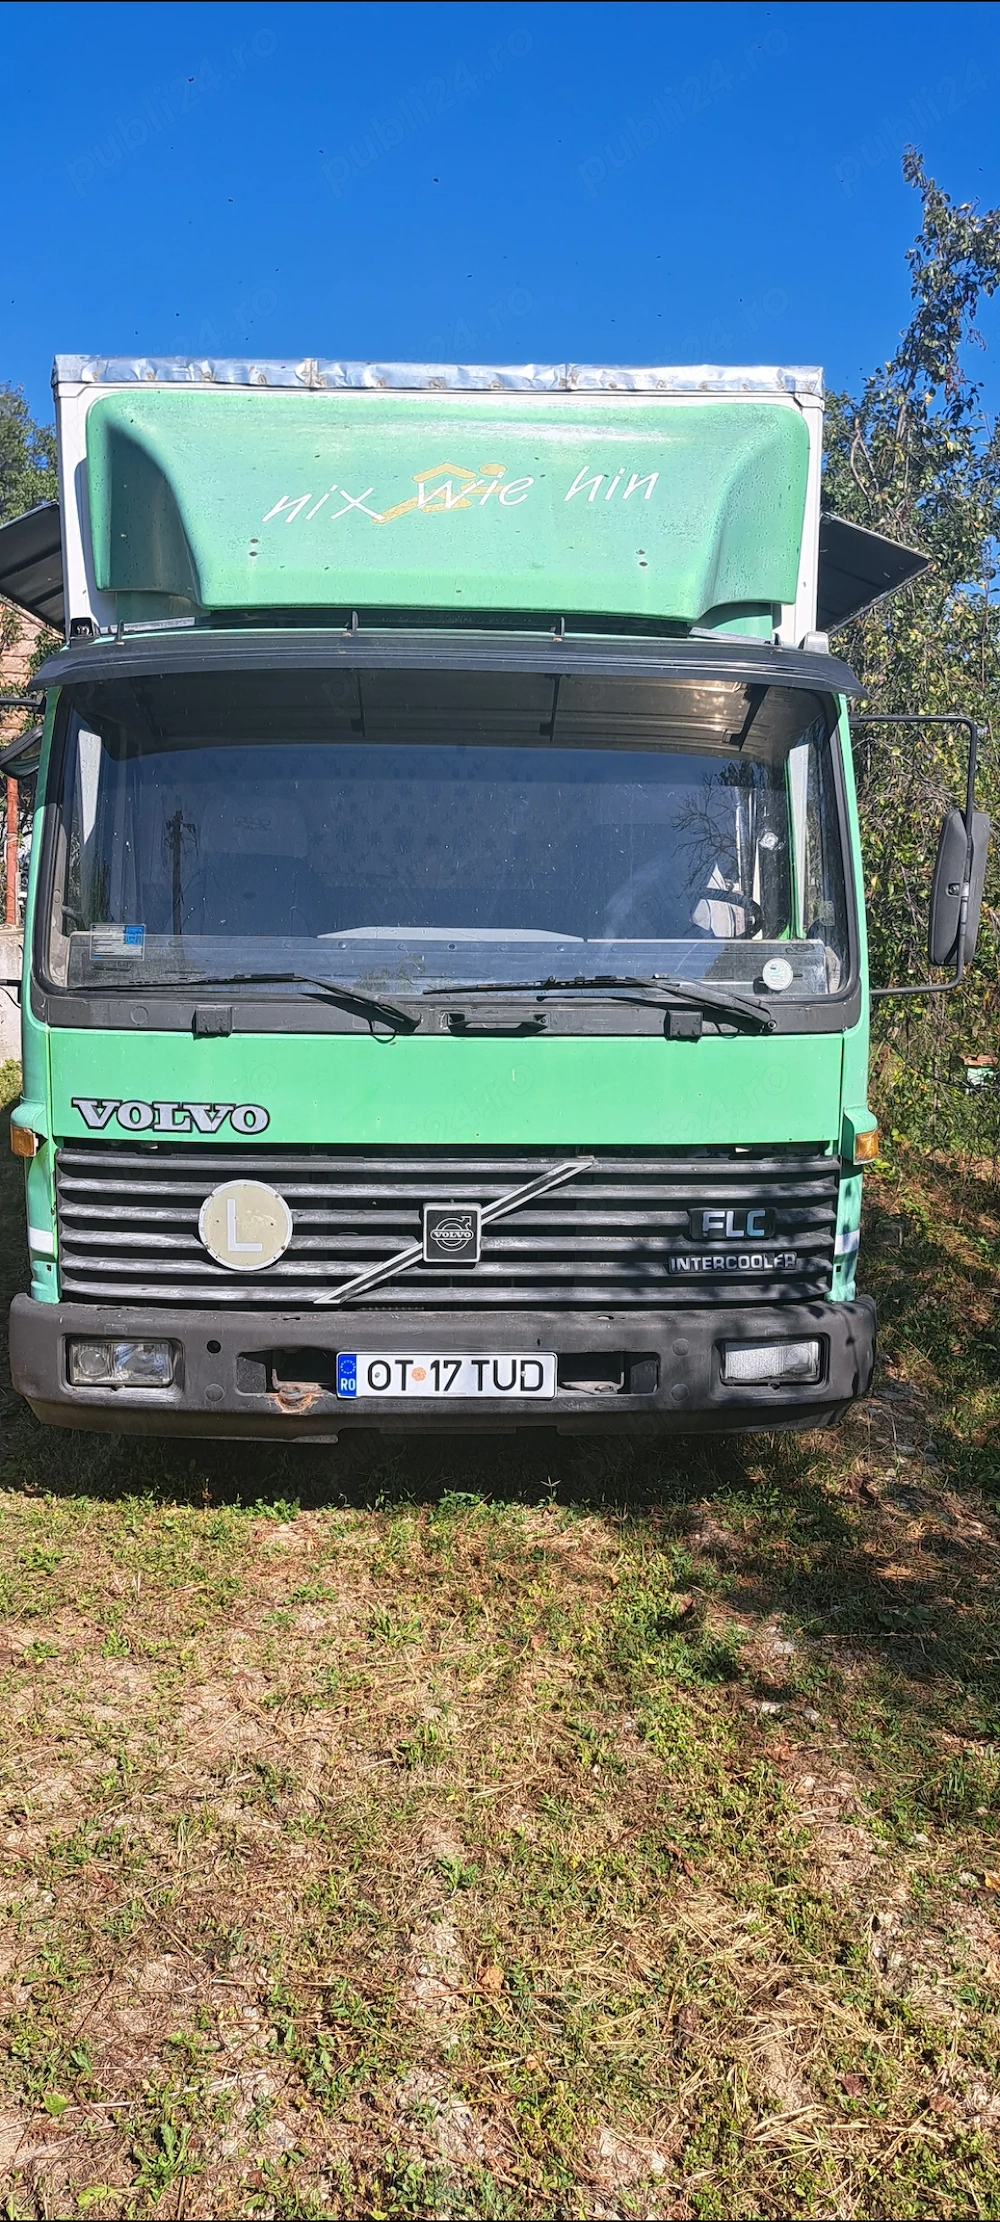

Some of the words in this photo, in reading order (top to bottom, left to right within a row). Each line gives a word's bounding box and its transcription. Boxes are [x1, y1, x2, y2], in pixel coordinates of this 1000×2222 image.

[261, 484, 385, 523] nix
[417, 472, 535, 511] wie
[563, 466, 660, 502] hin
[71, 1097, 270, 1135] VOLVO
[227, 1198, 263, 1251] L
[702, 1210, 766, 1237] FLC
[671, 1254, 796, 1271] INTERCOOLER
[340, 1378, 356, 1391] RO
[367, 1360, 414, 1391] OT
[430, 1360, 462, 1391] 17
[471, 1360, 544, 1391] TUD
